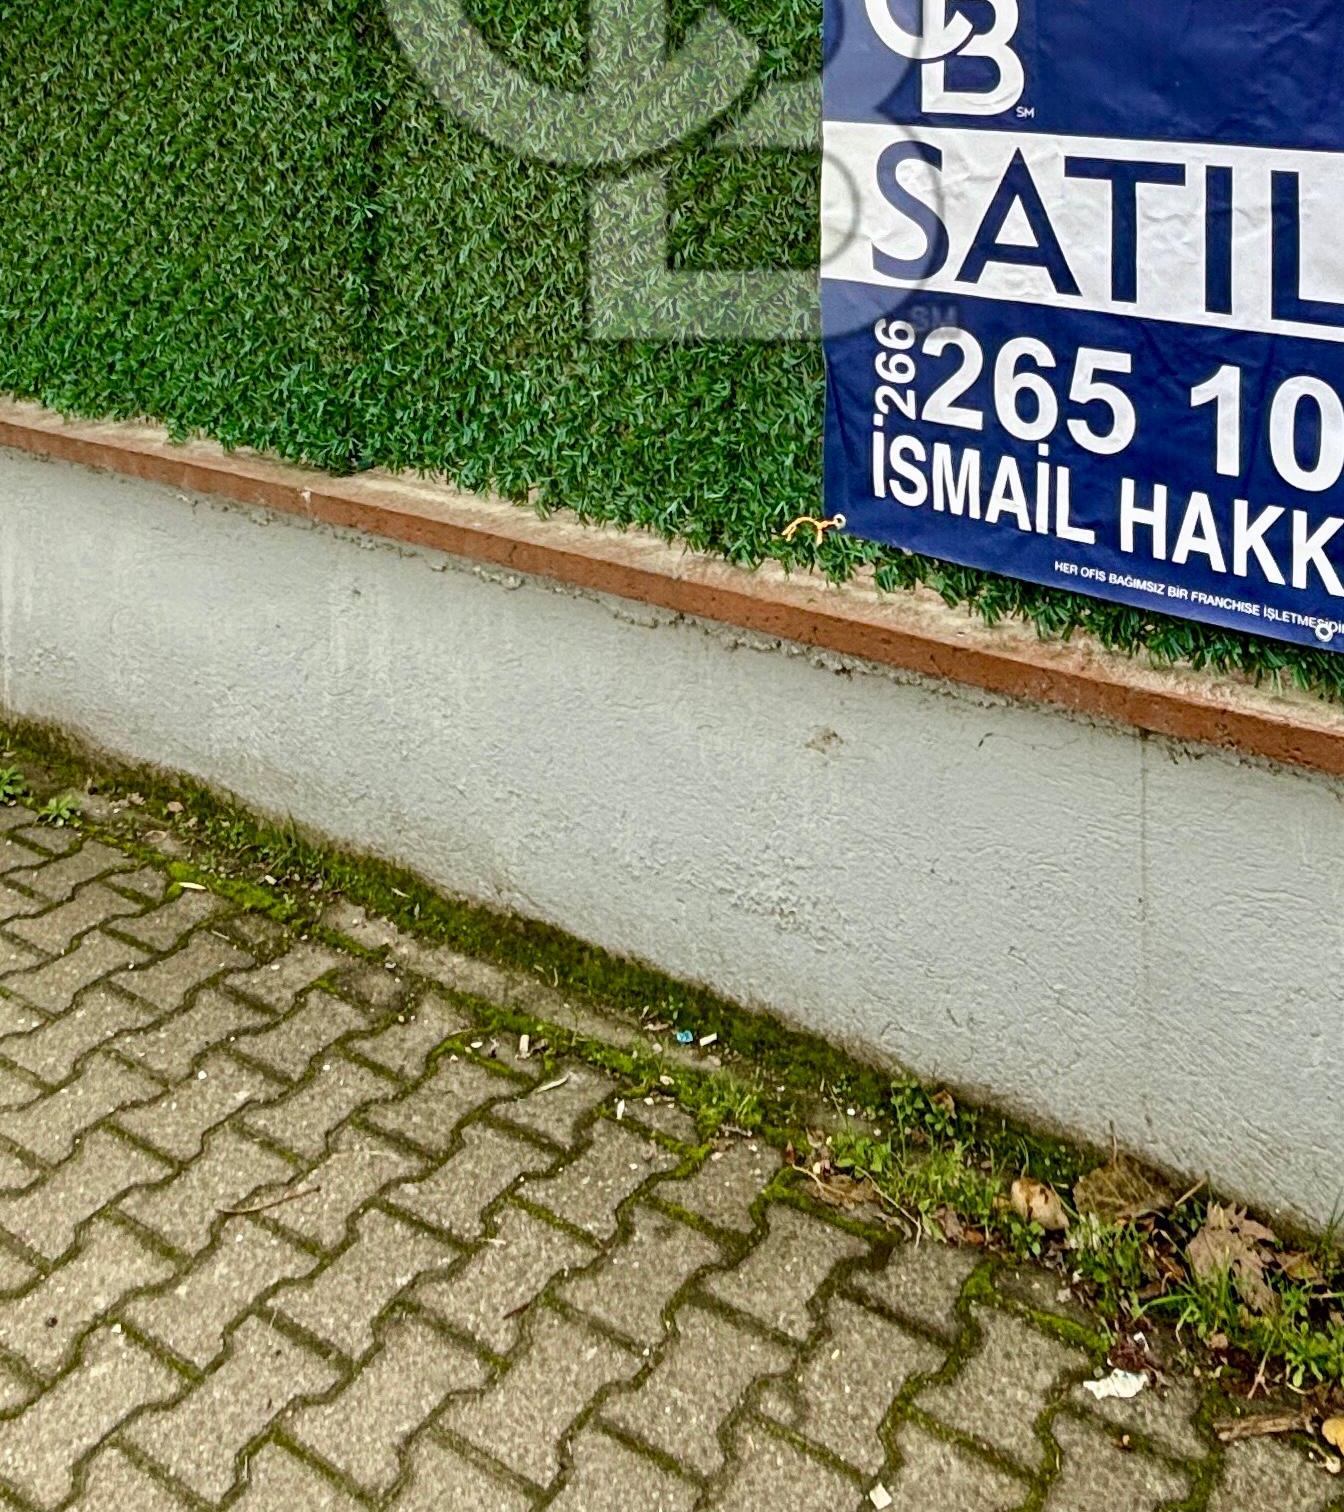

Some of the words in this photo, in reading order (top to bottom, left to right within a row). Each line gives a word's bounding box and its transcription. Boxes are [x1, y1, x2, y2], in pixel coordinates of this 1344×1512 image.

[873, 318, 916, 421] 266
[921, 326, 1136, 456] 265
[872, 414, 1096, 545] İSMAİL
[1054, 560, 1078, 576] HER
[1191, 591, 1261, 617] FRANCHISE
